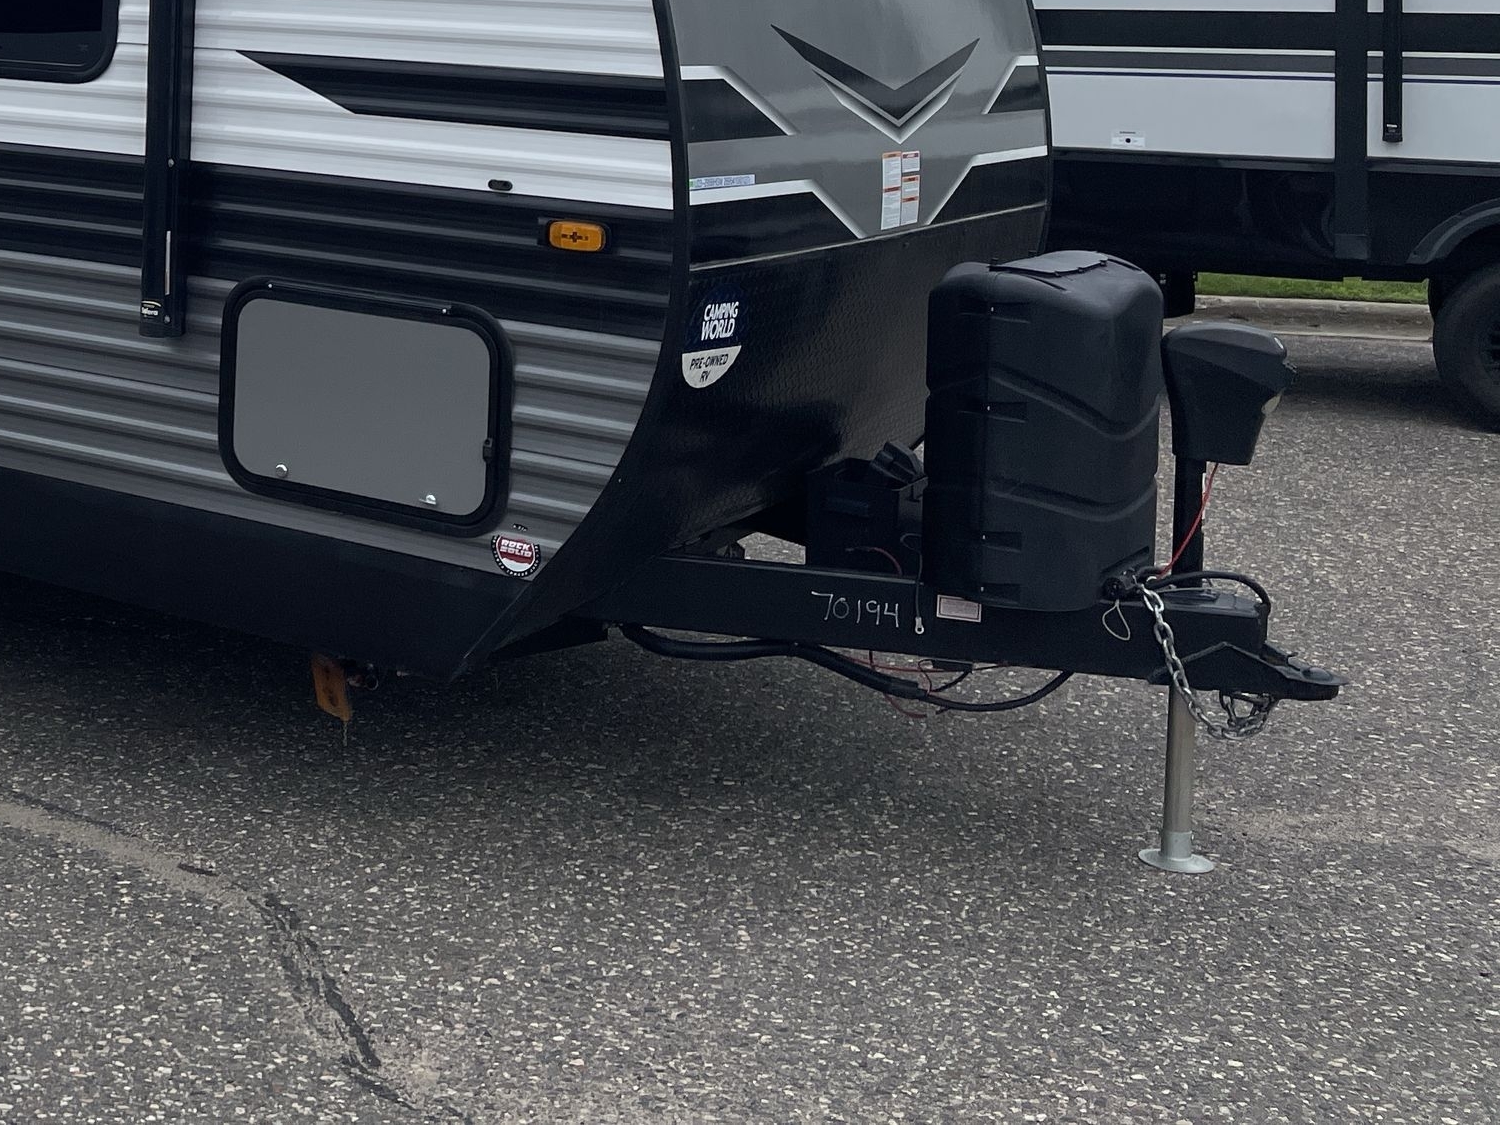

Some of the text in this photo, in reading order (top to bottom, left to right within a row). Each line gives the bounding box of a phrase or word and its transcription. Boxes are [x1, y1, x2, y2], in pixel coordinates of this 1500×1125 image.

[704, 301, 739, 321] CAMPING
[701, 318, 736, 341] WORLD
[690, 354, 729, 370] PRE-OWNED
[700, 371, 711, 383] RV
[500, 546, 532, 557] SOLID
[501, 539, 531, 551] ROCK
[811, 591, 899, 628] 70194
